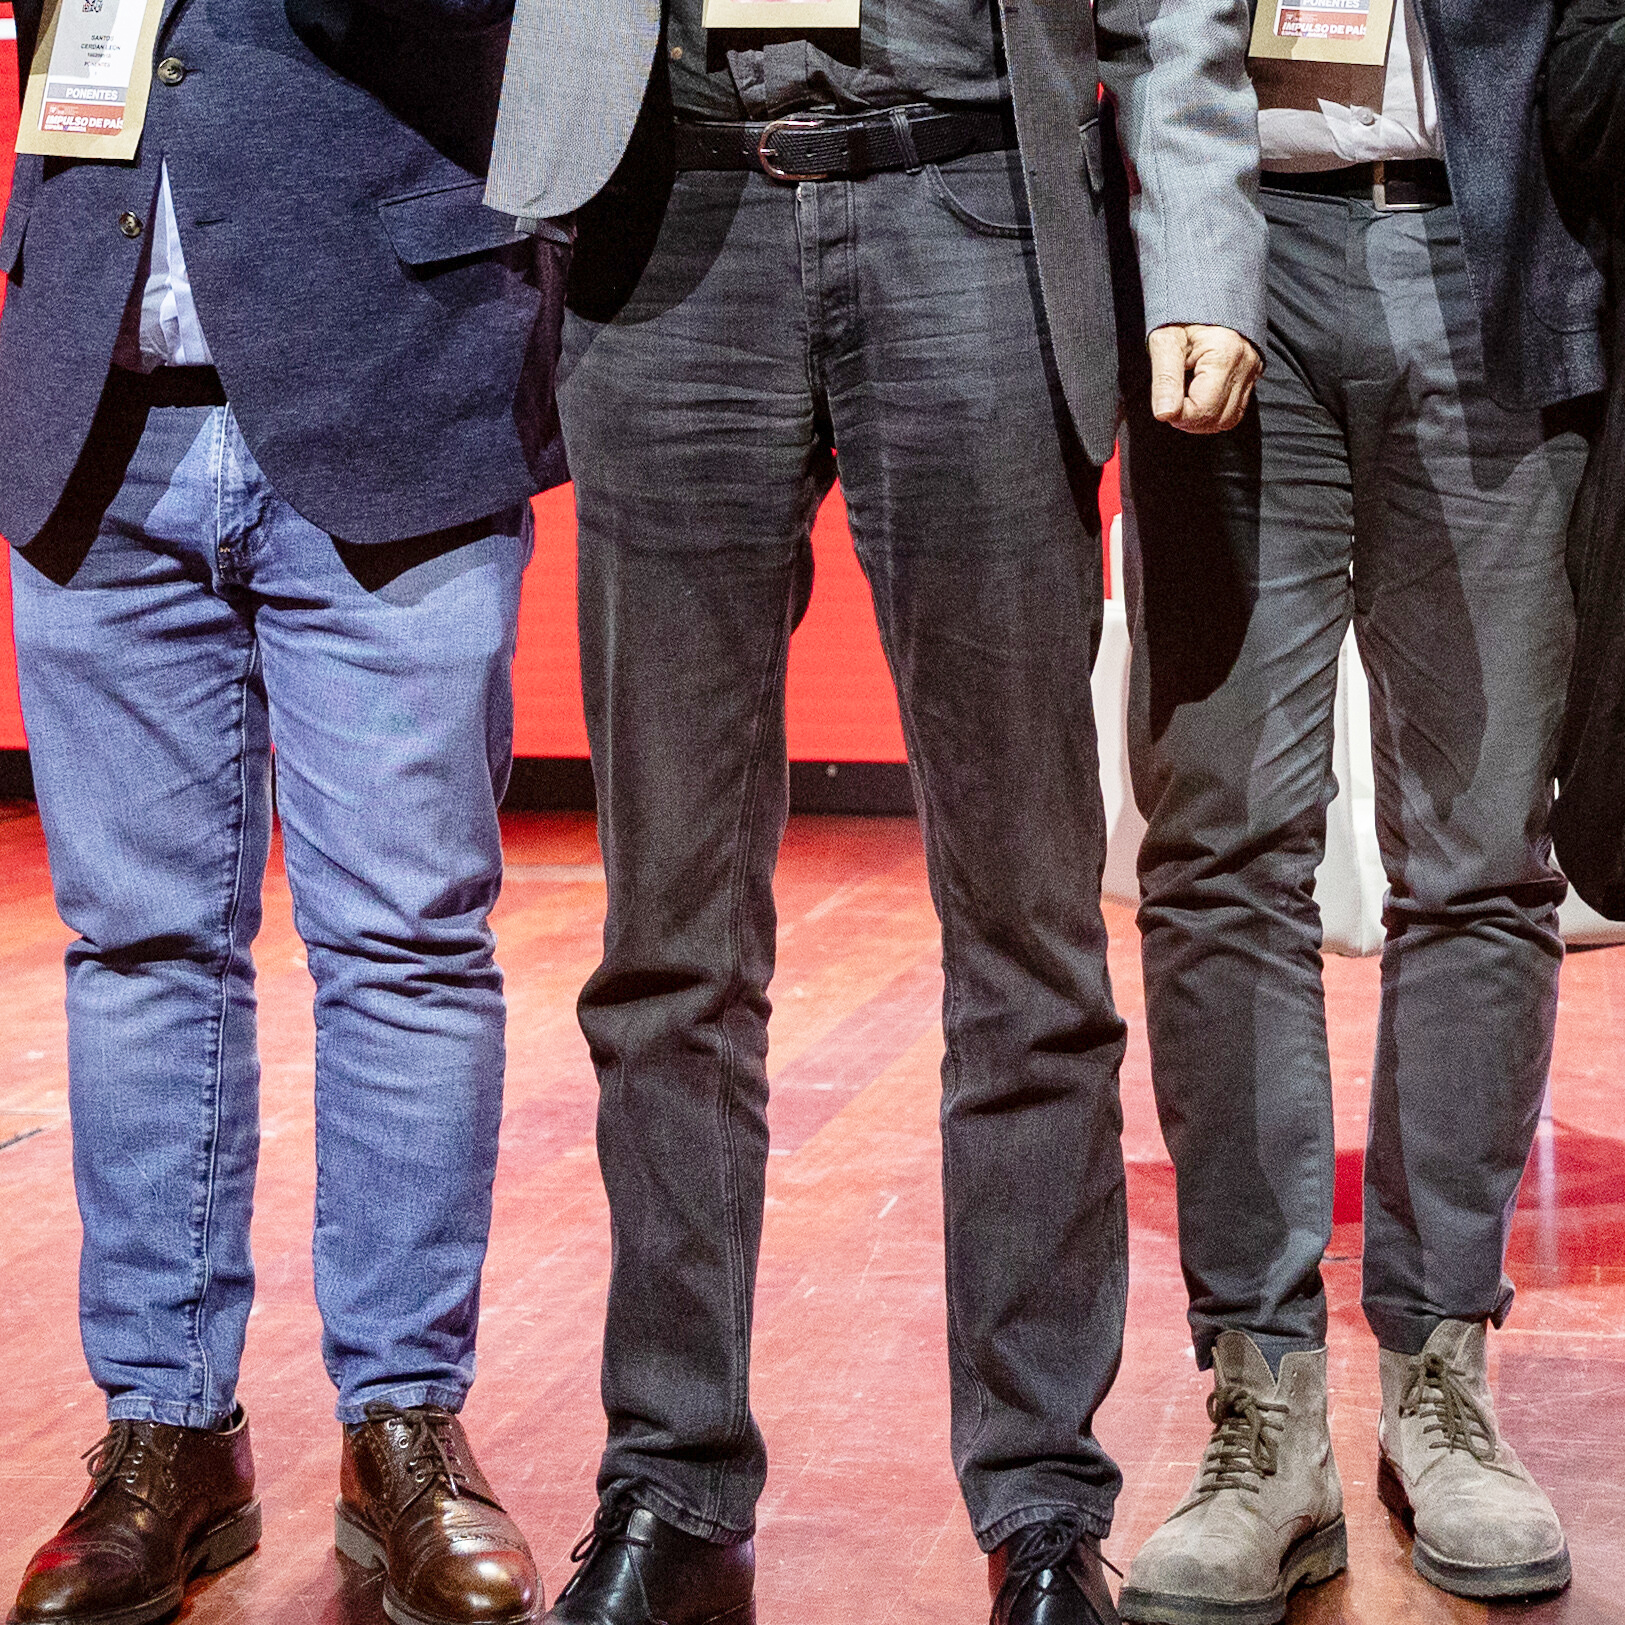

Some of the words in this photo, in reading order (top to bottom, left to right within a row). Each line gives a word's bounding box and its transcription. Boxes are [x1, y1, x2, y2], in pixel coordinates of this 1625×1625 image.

[1282, 22, 1329, 33] IMPULSO
[1330, 24, 1345, 34] DE
[66, 87, 119, 100] PONENTES
[46, 115, 89, 127] IMPULSO
[89, 117, 104, 128] DE
